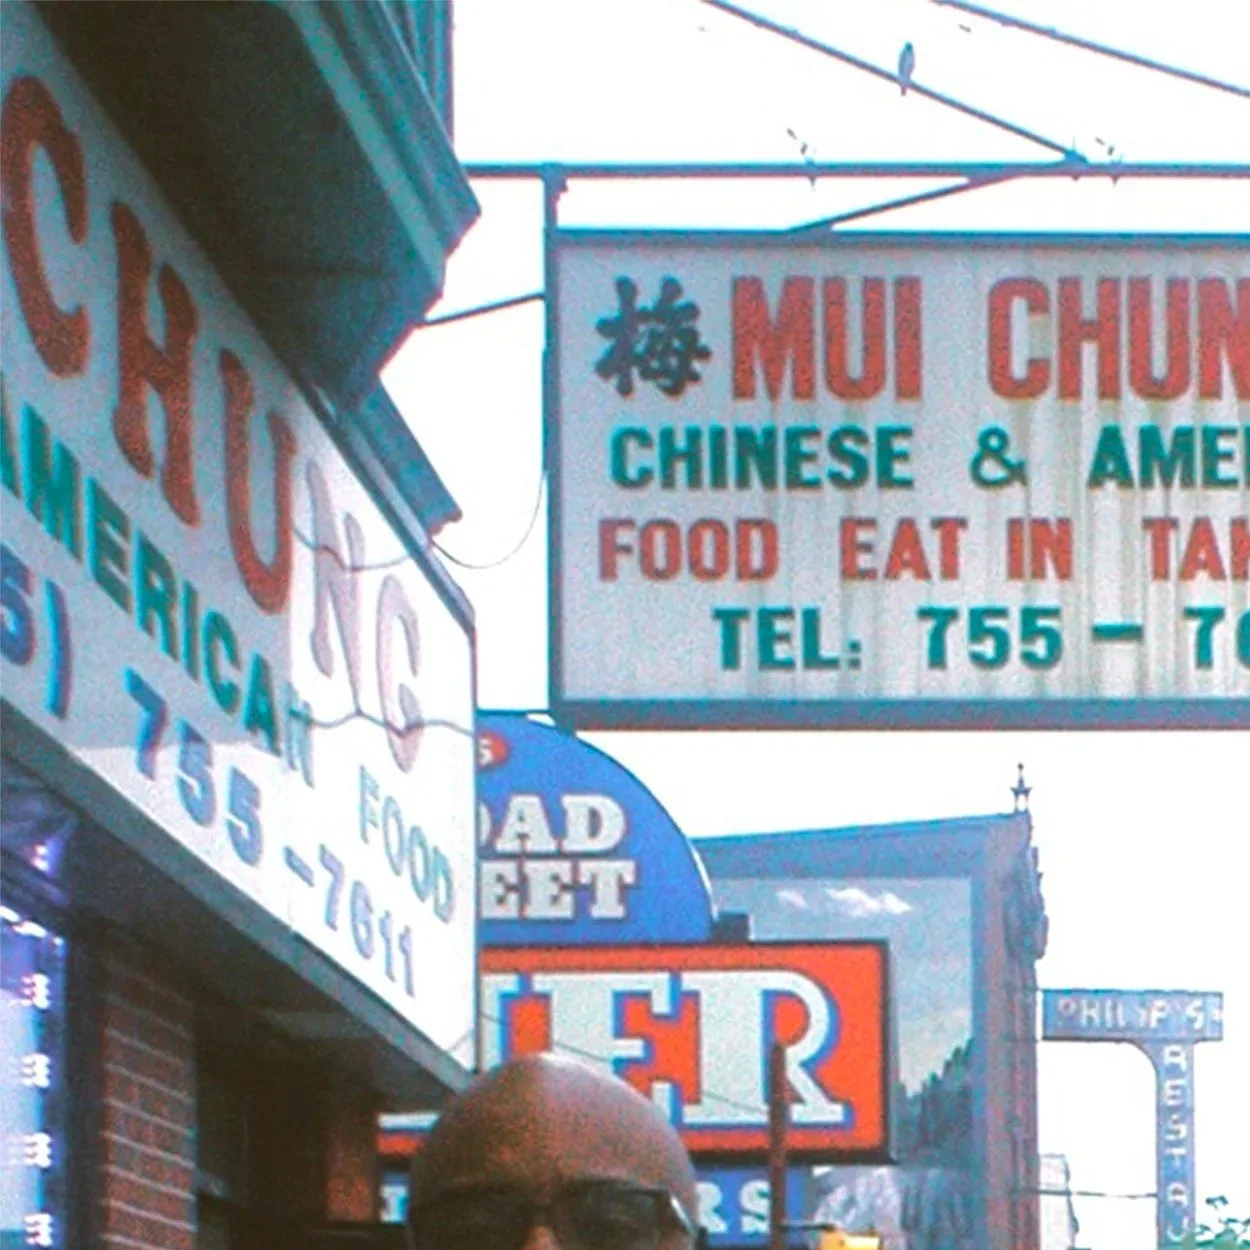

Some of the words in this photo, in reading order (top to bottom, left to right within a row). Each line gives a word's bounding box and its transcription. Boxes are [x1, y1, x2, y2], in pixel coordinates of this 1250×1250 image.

[593, 276, 713, 398] 梅
[729, 274, 924, 401] MUI
[2, 75, 423, 775] CHUNG
[609, 425, 915, 491] CHINESE
[968, 426, 1030, 491] &
[598, 517, 780, 583] FOOD
[838, 517, 968, 583] EAT
[1006, 517, 1074, 583] IN
[711, 606, 862, 672] TEL:
[916, 606, 1064, 672] 755
[358, 764, 455, 925] FOOD
[479, 793, 627, 853] AD
